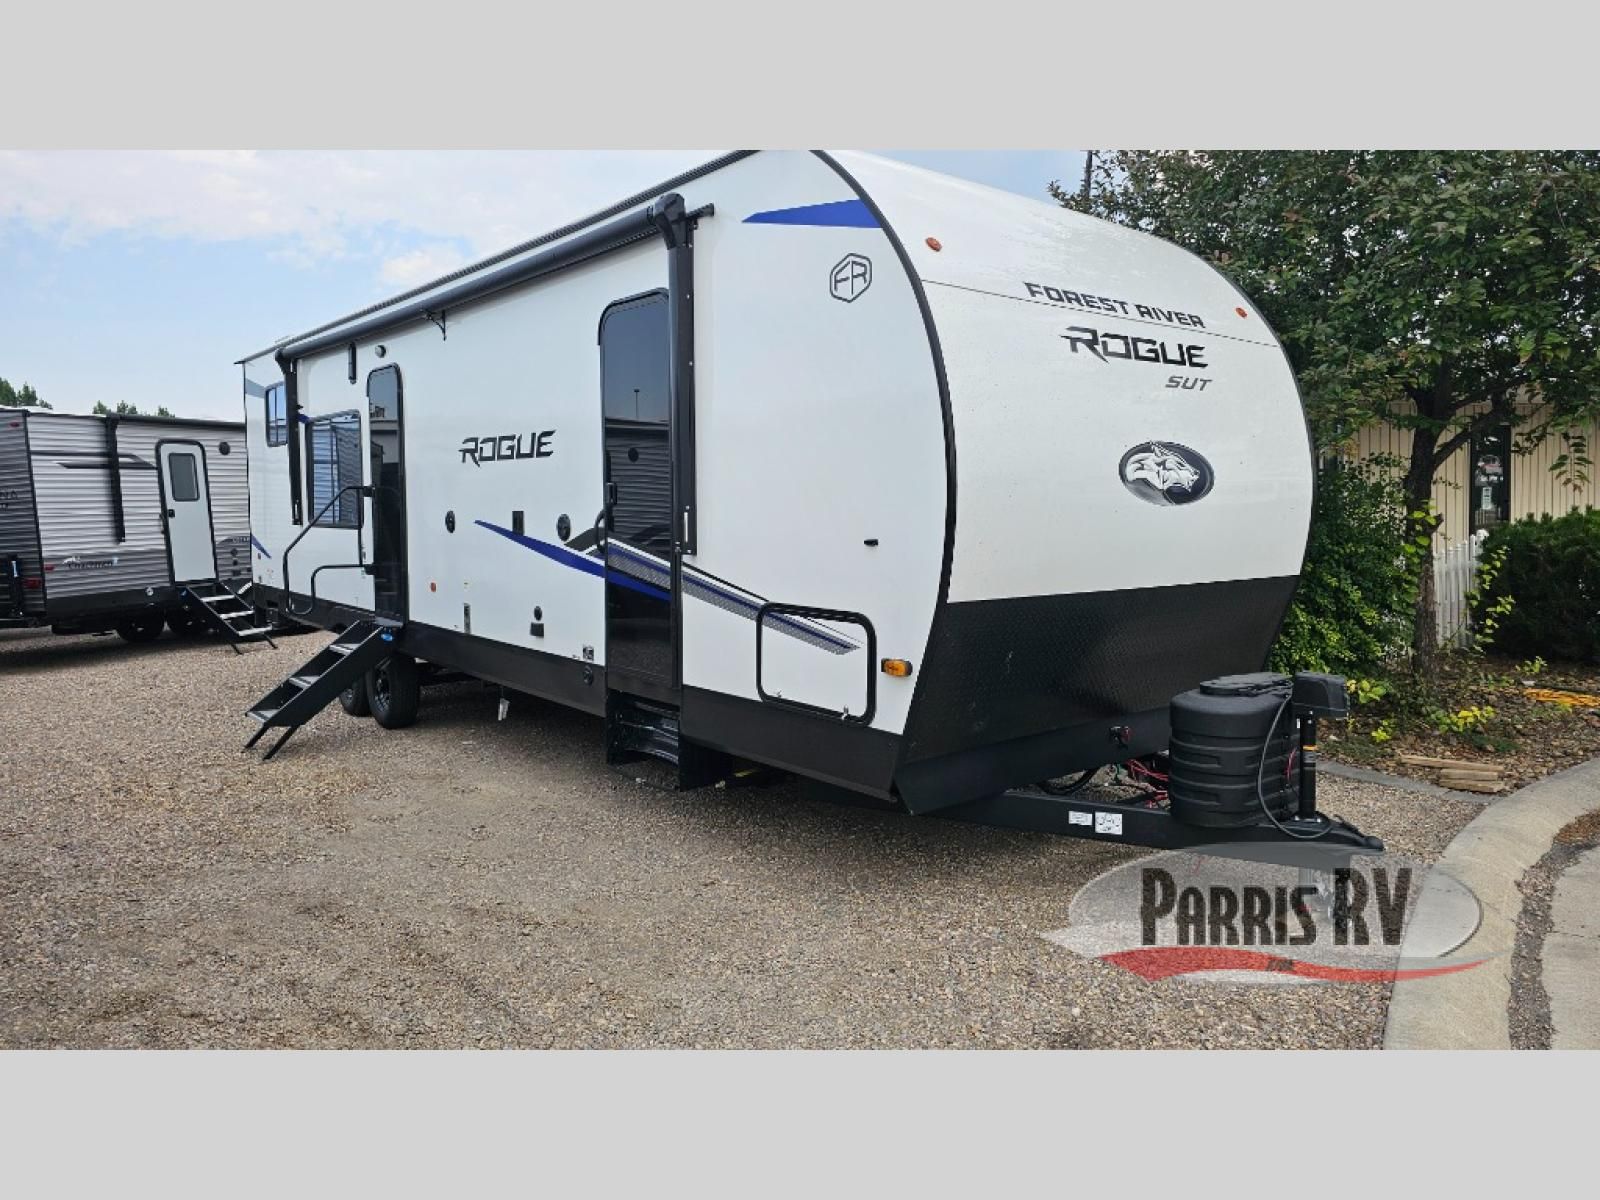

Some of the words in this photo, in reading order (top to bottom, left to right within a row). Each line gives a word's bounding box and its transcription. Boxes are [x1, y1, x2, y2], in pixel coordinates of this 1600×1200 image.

[1023, 281, 1129, 315] FOREST
[1133, 303, 1206, 329] RIVER
[1059, 325, 1209, 368] ROGUE
[1164, 375, 1213, 392] SUT
[458, 429, 556, 468] ROGUE
